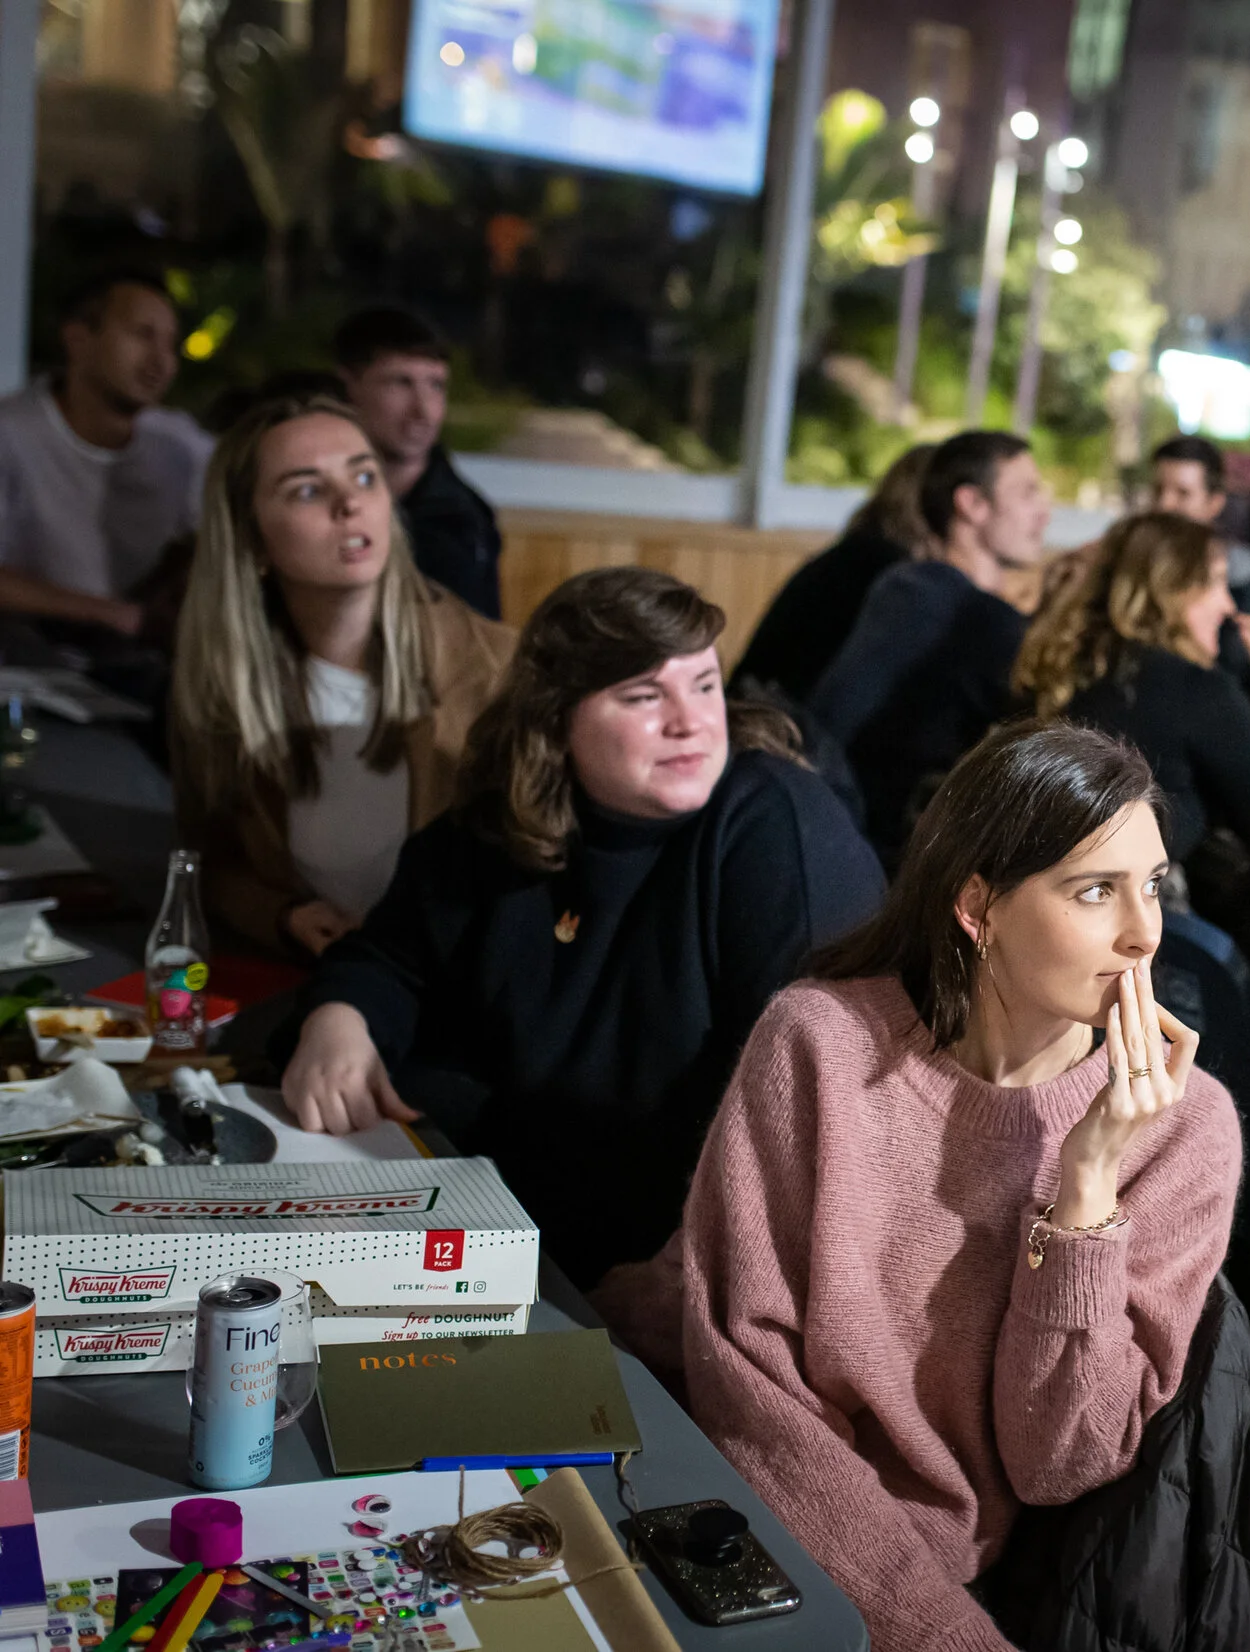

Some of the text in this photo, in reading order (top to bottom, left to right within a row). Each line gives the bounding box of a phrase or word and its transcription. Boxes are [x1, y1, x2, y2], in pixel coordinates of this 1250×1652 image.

[110, 1195, 422, 1216] Krispy Kreme
[433, 1242, 455, 1259] 12
[68, 1274, 169, 1294] Krispy Kreme
[393, 1283, 413, 1291] LET'S
[426, 1283, 449, 1292] friends
[84, 1295, 148, 1303] DOUGHNUTS
[402, 1312, 515, 1329] free DOUGHNUT?
[63, 1332, 165, 1353] Krispy Kreme
[226, 1322, 280, 1351] Fine
[382, 1329, 515, 1342] Sign up TO OUR NEWSLETTER
[80, 1353, 143, 1361] DOUGHNUTS
[359, 1352, 457, 1371] notes
[245, 1394, 256, 1407] &
